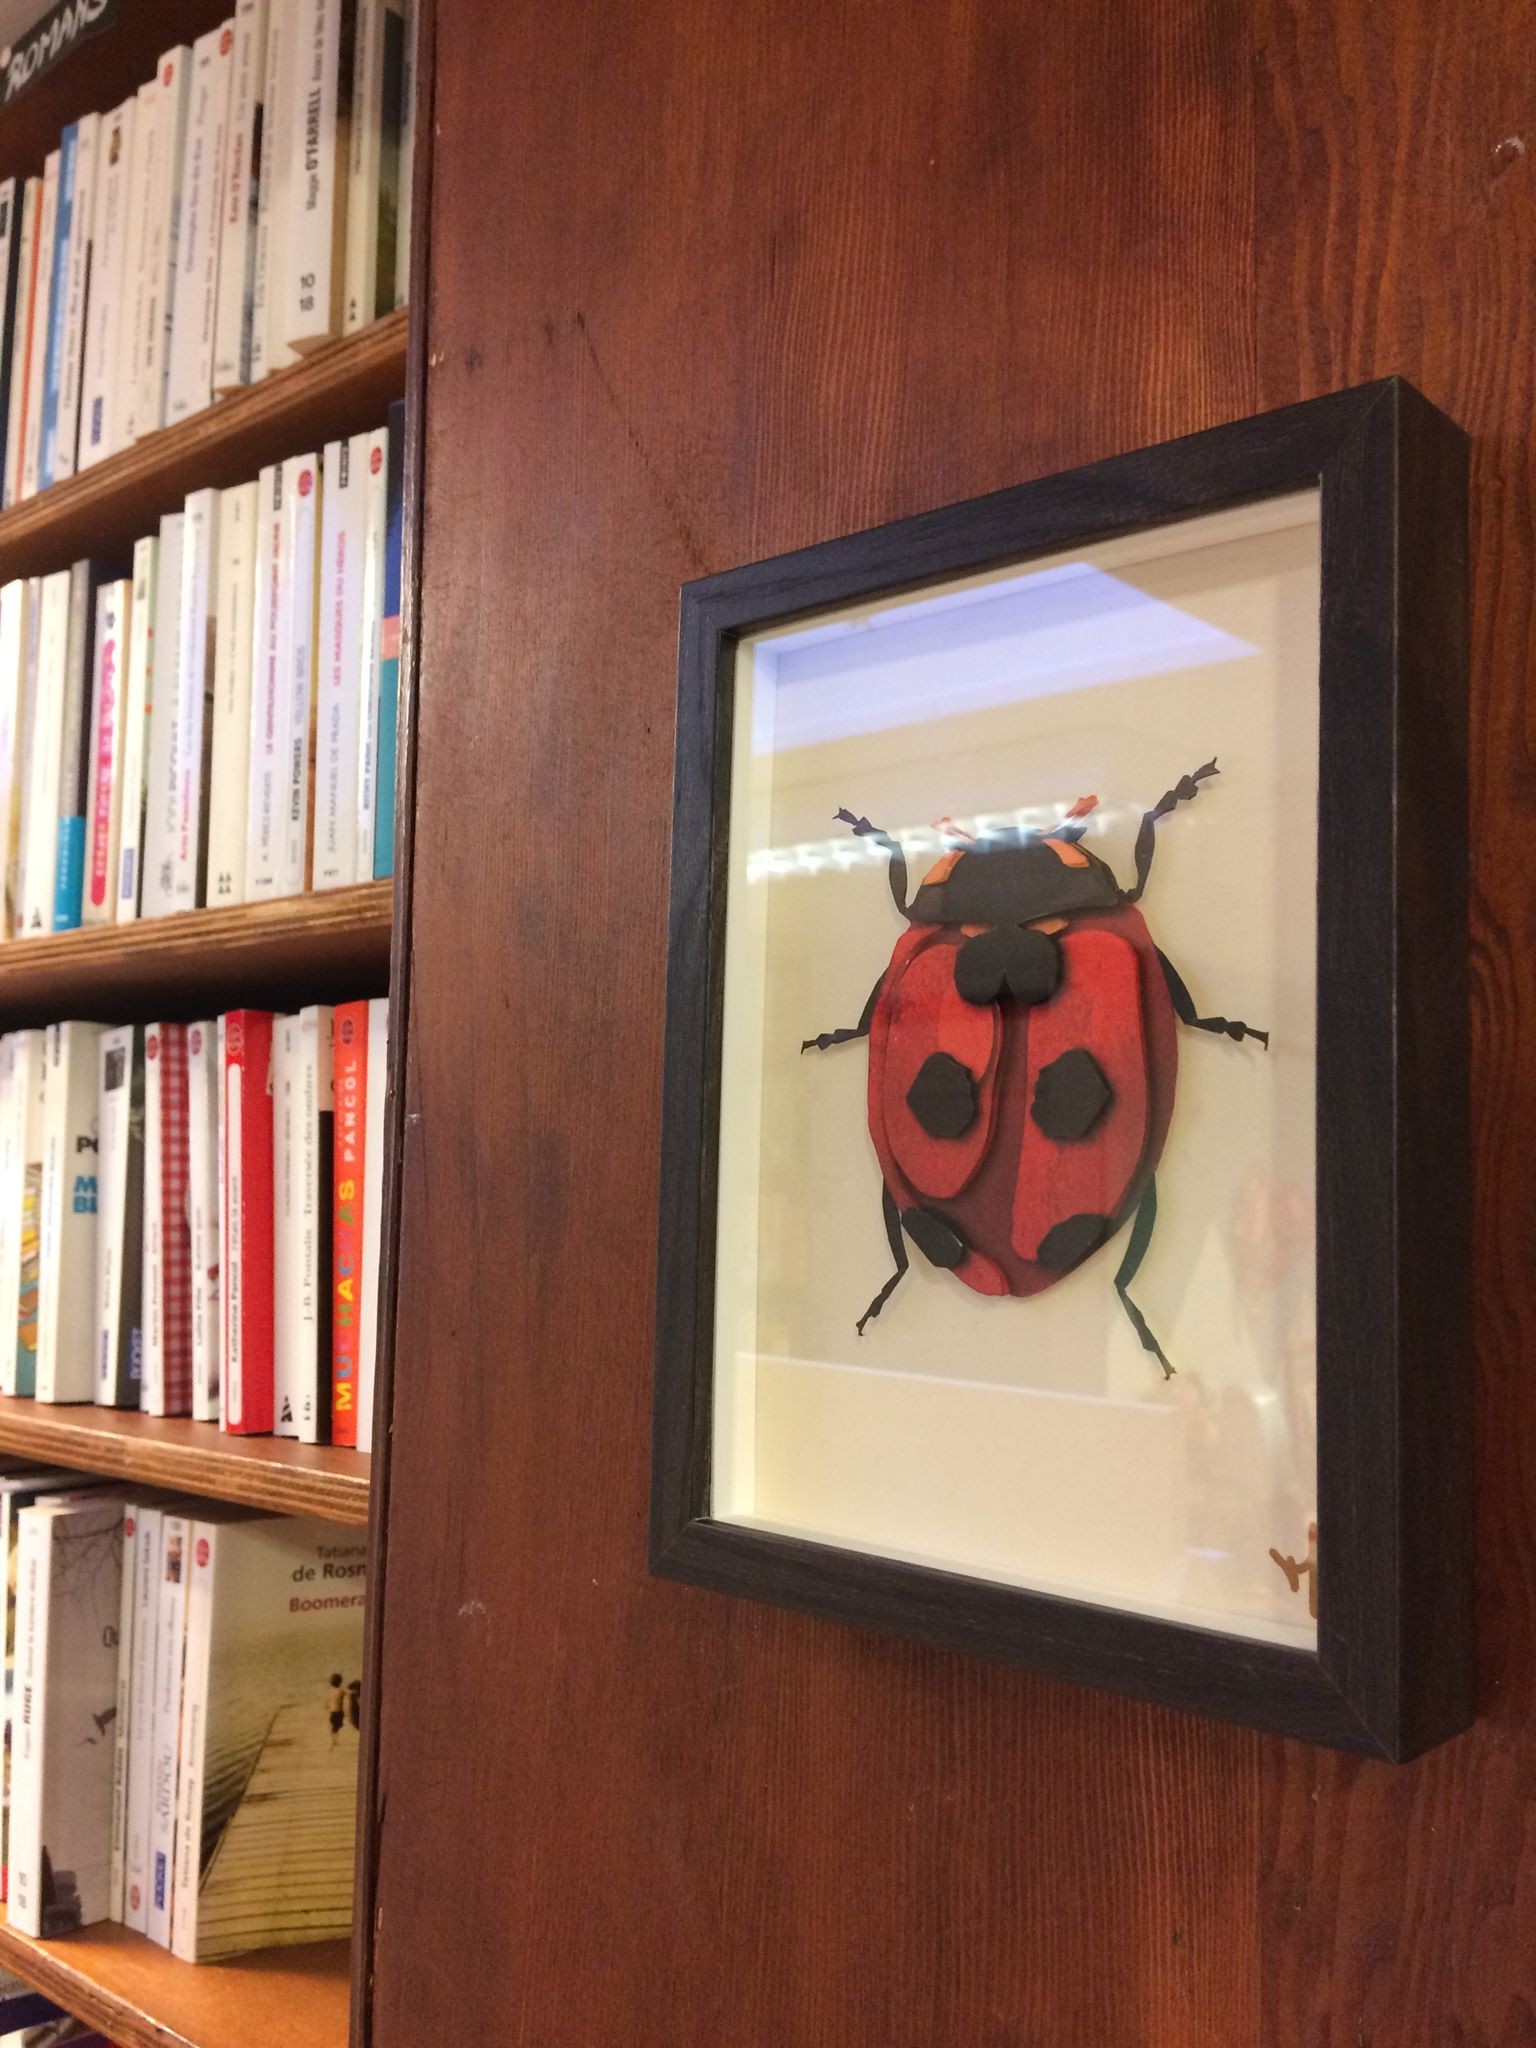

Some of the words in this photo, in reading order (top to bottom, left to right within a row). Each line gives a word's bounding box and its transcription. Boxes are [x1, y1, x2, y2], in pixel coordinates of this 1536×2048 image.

[305, 88, 321, 171] O'FARRELL
[292, 737, 302, 785] POWERS
[291, 788, 301, 822] KEVIN
[343, 1060, 357, 1163] PANCOL
[335, 1180, 355, 1411] MUCHACHAS
[292, 1565, 316, 1582] de
